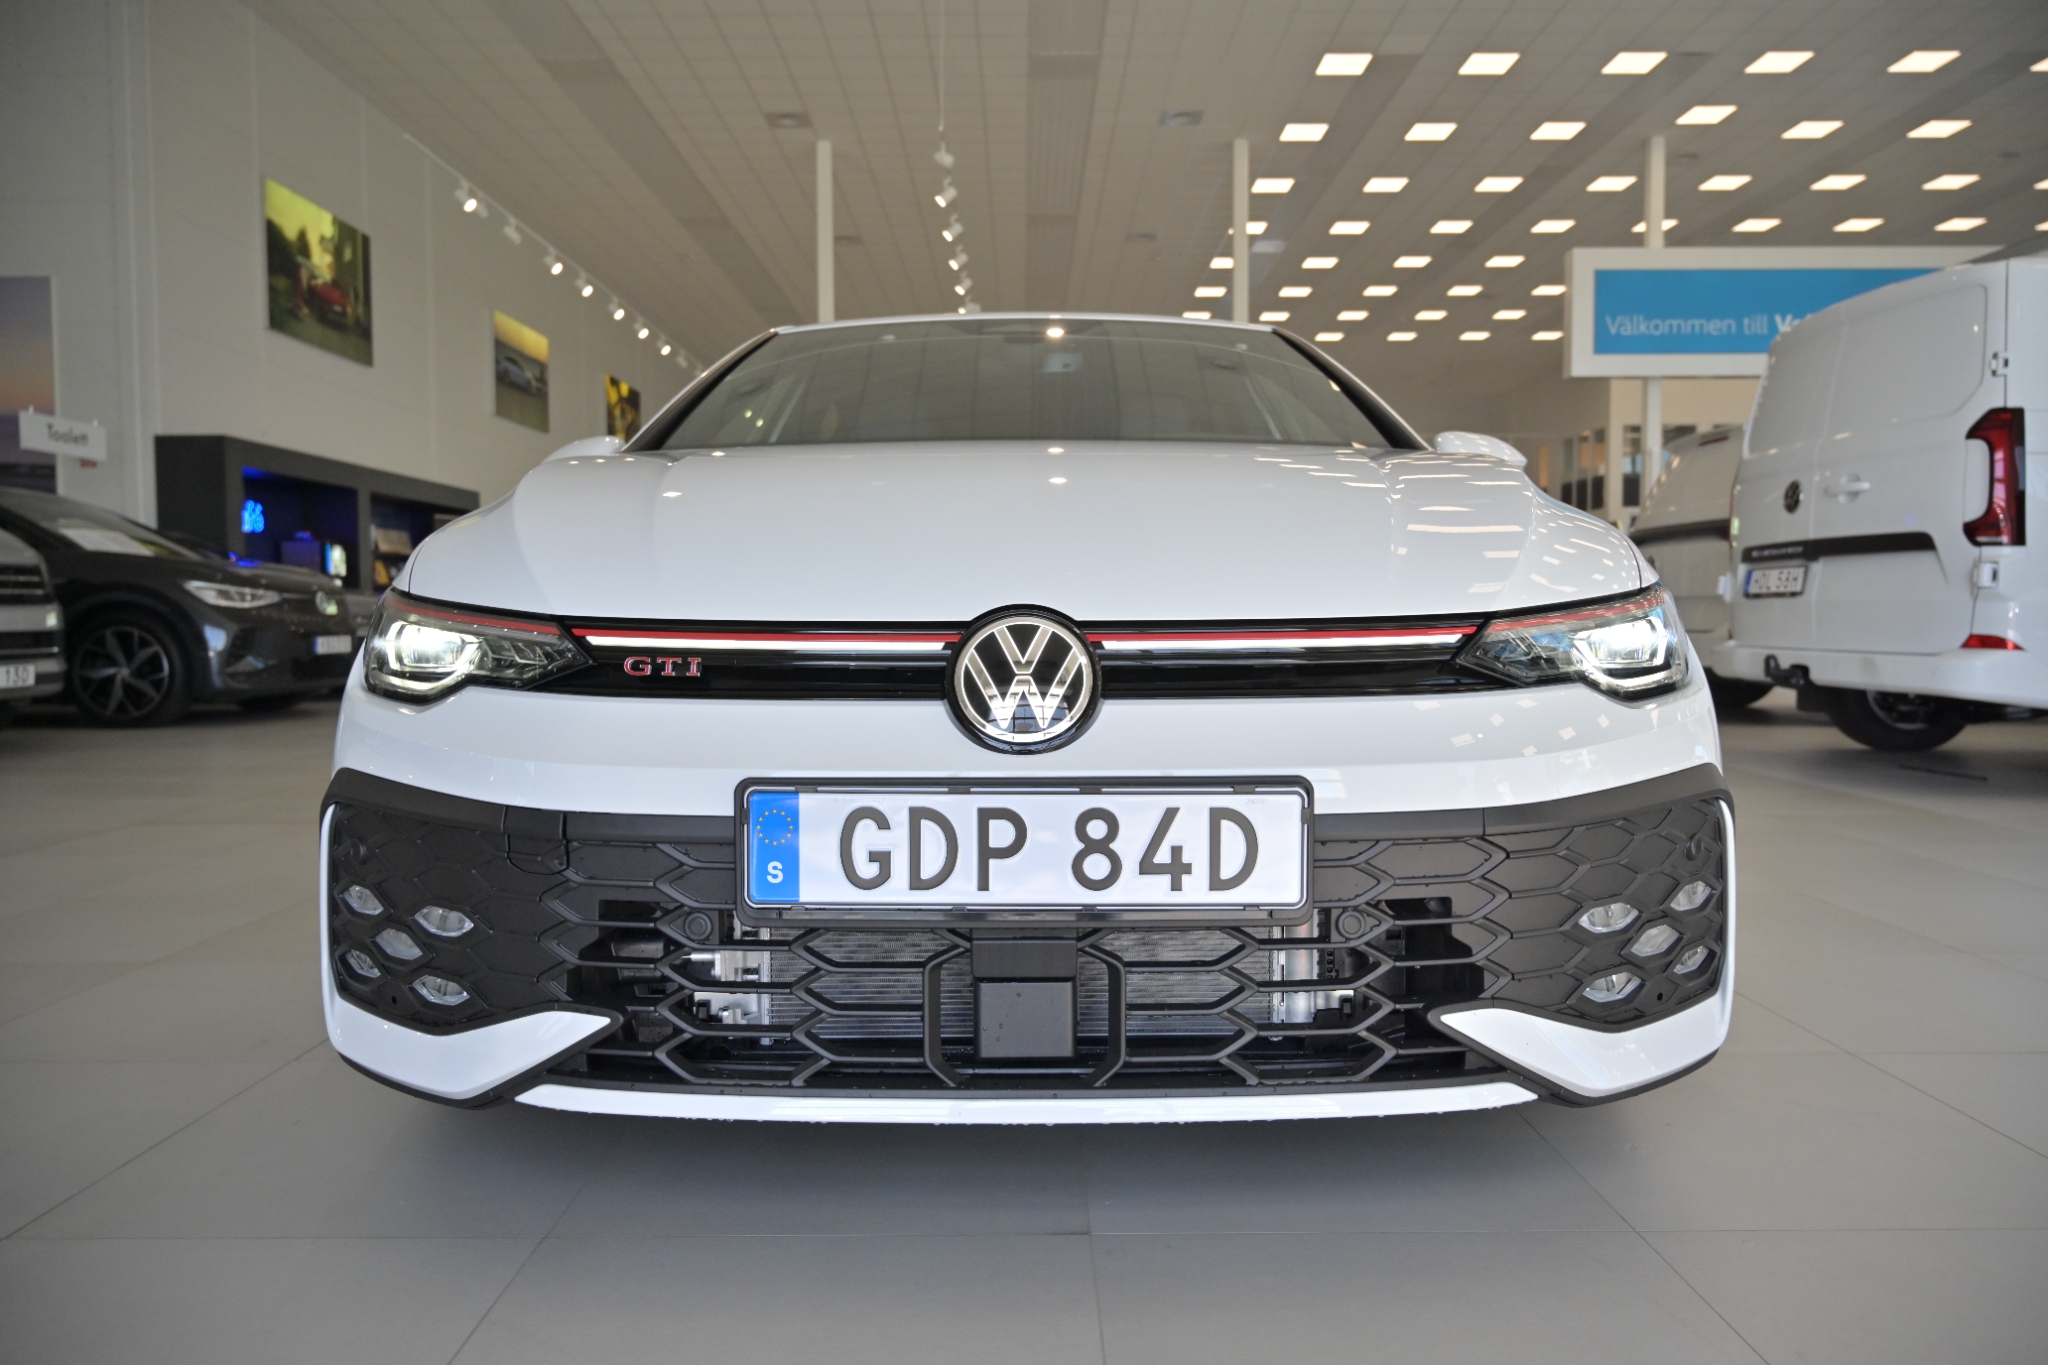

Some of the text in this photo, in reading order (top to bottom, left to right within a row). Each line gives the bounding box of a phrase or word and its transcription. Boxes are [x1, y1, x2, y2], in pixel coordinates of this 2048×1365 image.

[1605, 314, 1737, 336] Välkommen
[1742, 313, 1769, 335] till
[623, 655, 702, 677] GTI
[840, 806, 1259, 892] GDP 84D
[766, 861, 785, 884] S
